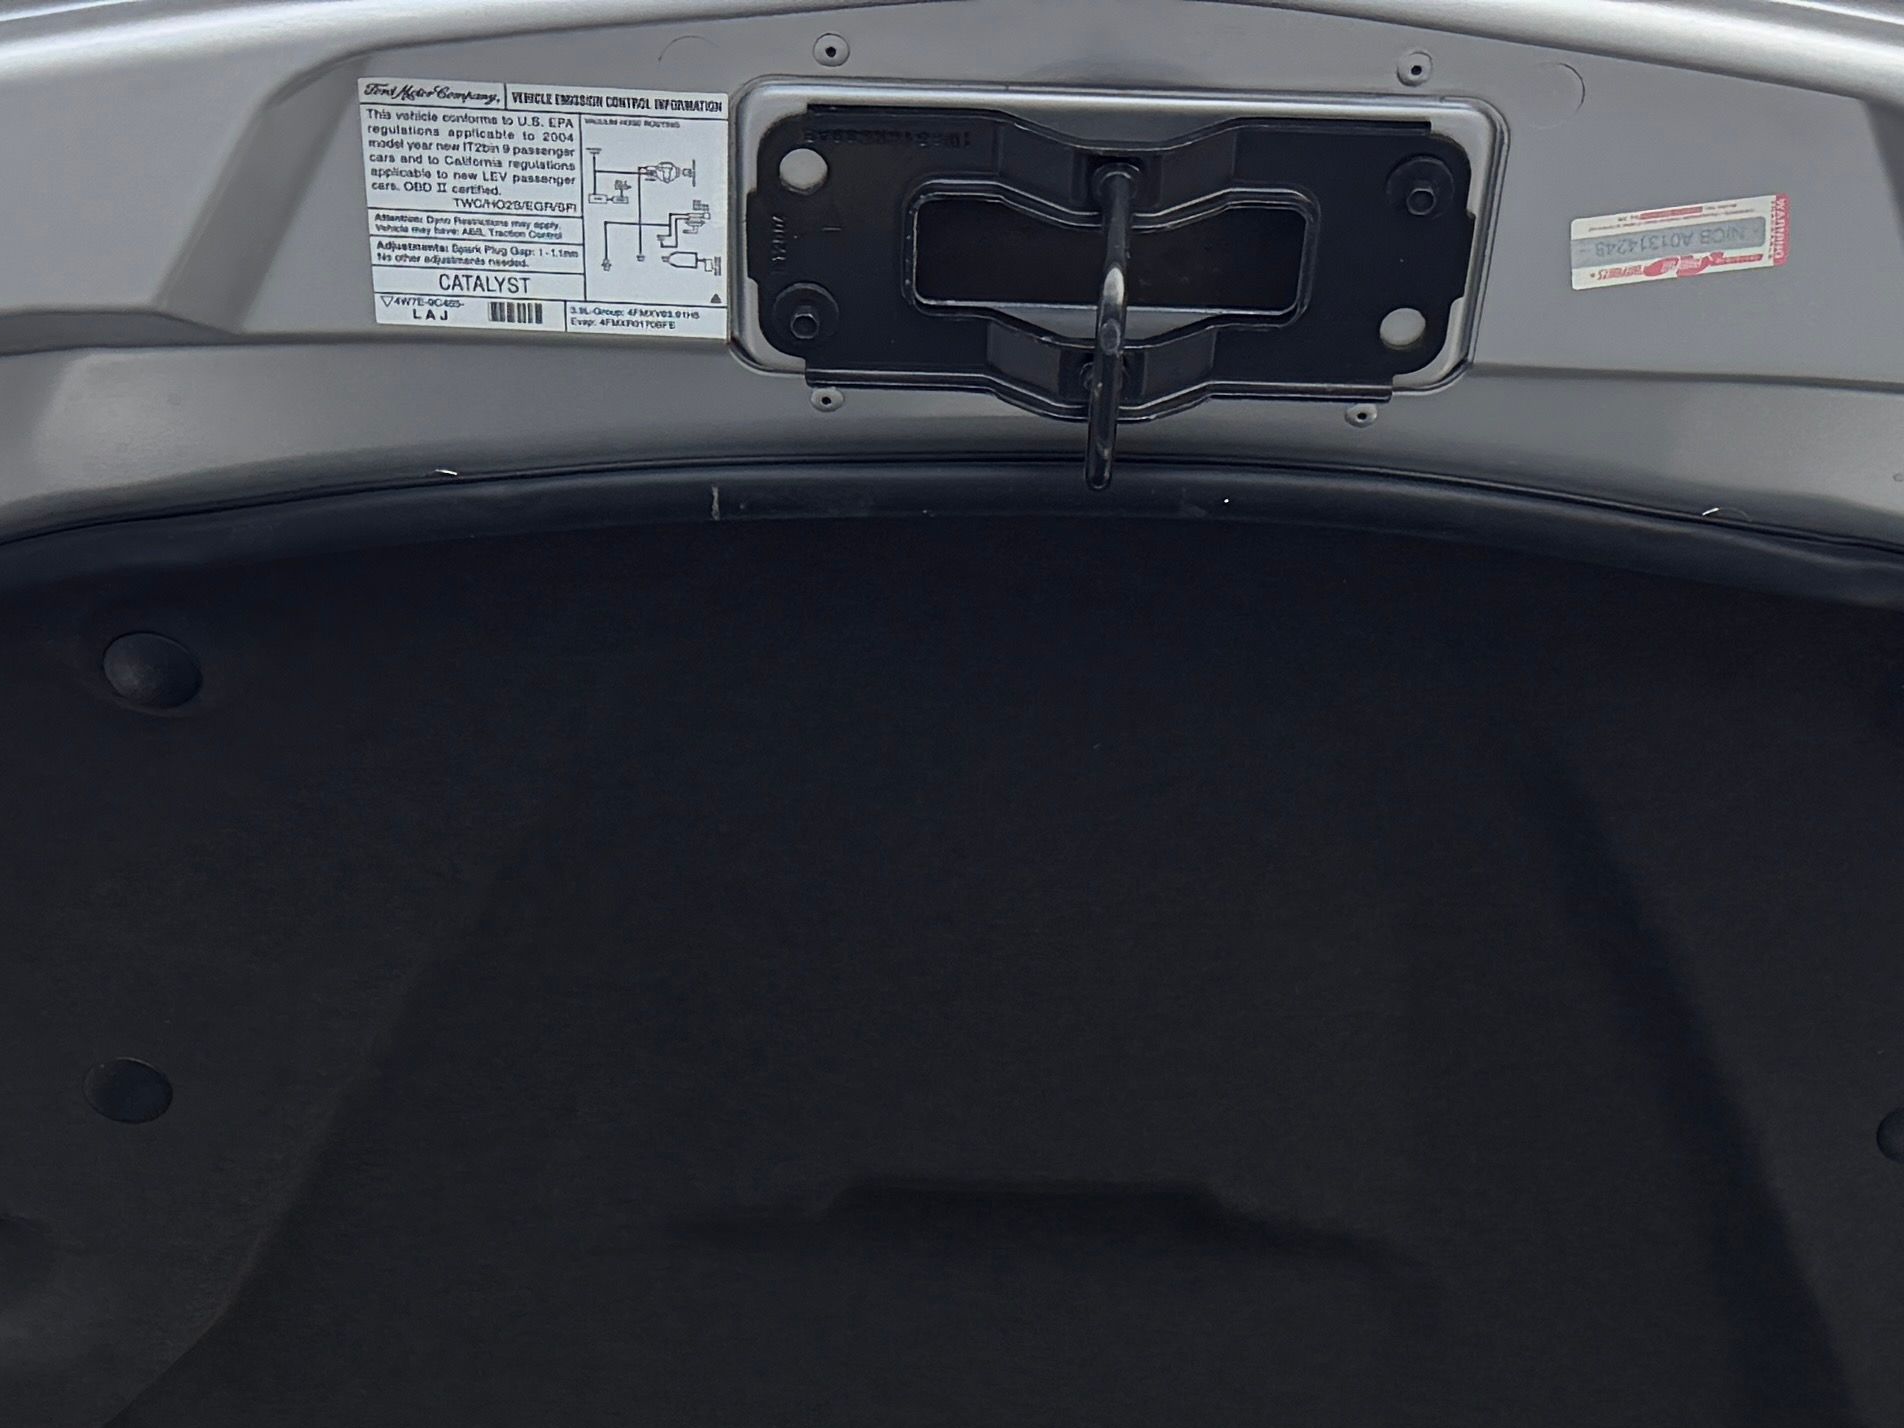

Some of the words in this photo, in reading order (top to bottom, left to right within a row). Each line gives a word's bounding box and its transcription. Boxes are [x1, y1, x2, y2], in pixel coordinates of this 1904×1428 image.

[511, 91, 552, 104] VEHICLE
[555, 93, 603, 107] EMISSION
[606, 96, 651, 110] CONTROL
[654, 98, 723, 113] INFORMATION
[366, 108, 392, 120] This
[396, 110, 438, 122] vehicle
[442, 111, 498, 126] conforms
[501, 115, 514, 126] to
[517, 116, 544, 128] U.S.
[548, 117, 574, 129] EPA
[367, 124, 440, 138] regulations
[448, 127, 515, 142] applicable
[522, 130, 535, 141] to
[542, 132, 574, 143] 2004
[369, 138, 404, 149] model
[407, 141, 433, 153] year
[436, 143, 461, 152] new
[512, 146, 576, 160] passenger
[369, 154, 396, 164] cars
[400, 154, 423, 165] and
[427, 155, 440, 166] to
[444, 155, 503, 169] California
[508, 160, 576, 174] regulations
[370, 167, 432, 180] applicable
[436, 169, 449, 180] to
[453, 170, 478, 181] new
[482, 171, 508, 183] LEV
[512, 174, 576, 188] passenger
[371, 181, 400, 191] cars.
[403, 181, 433, 193] OBD
[436, 181, 448, 193] II
[451, 183, 502, 197] certified.
[374, 212, 424, 224] Attention:
[511, 219, 533, 230] may
[374, 223, 409, 234] Vehicle
[410, 225, 432, 236] may
[488, 228, 526, 239] Traction
[527, 229, 563, 240] Control
[376, 240, 449, 253] Adjustments:
[451, 243, 482, 255] Spark
[484, 244, 508, 258] Plug
[377, 252, 393, 263] No
[394, 252, 422, 264] other
[424, 254, 486, 267] adjustments
[438, 272, 531, 295] CATALYST
